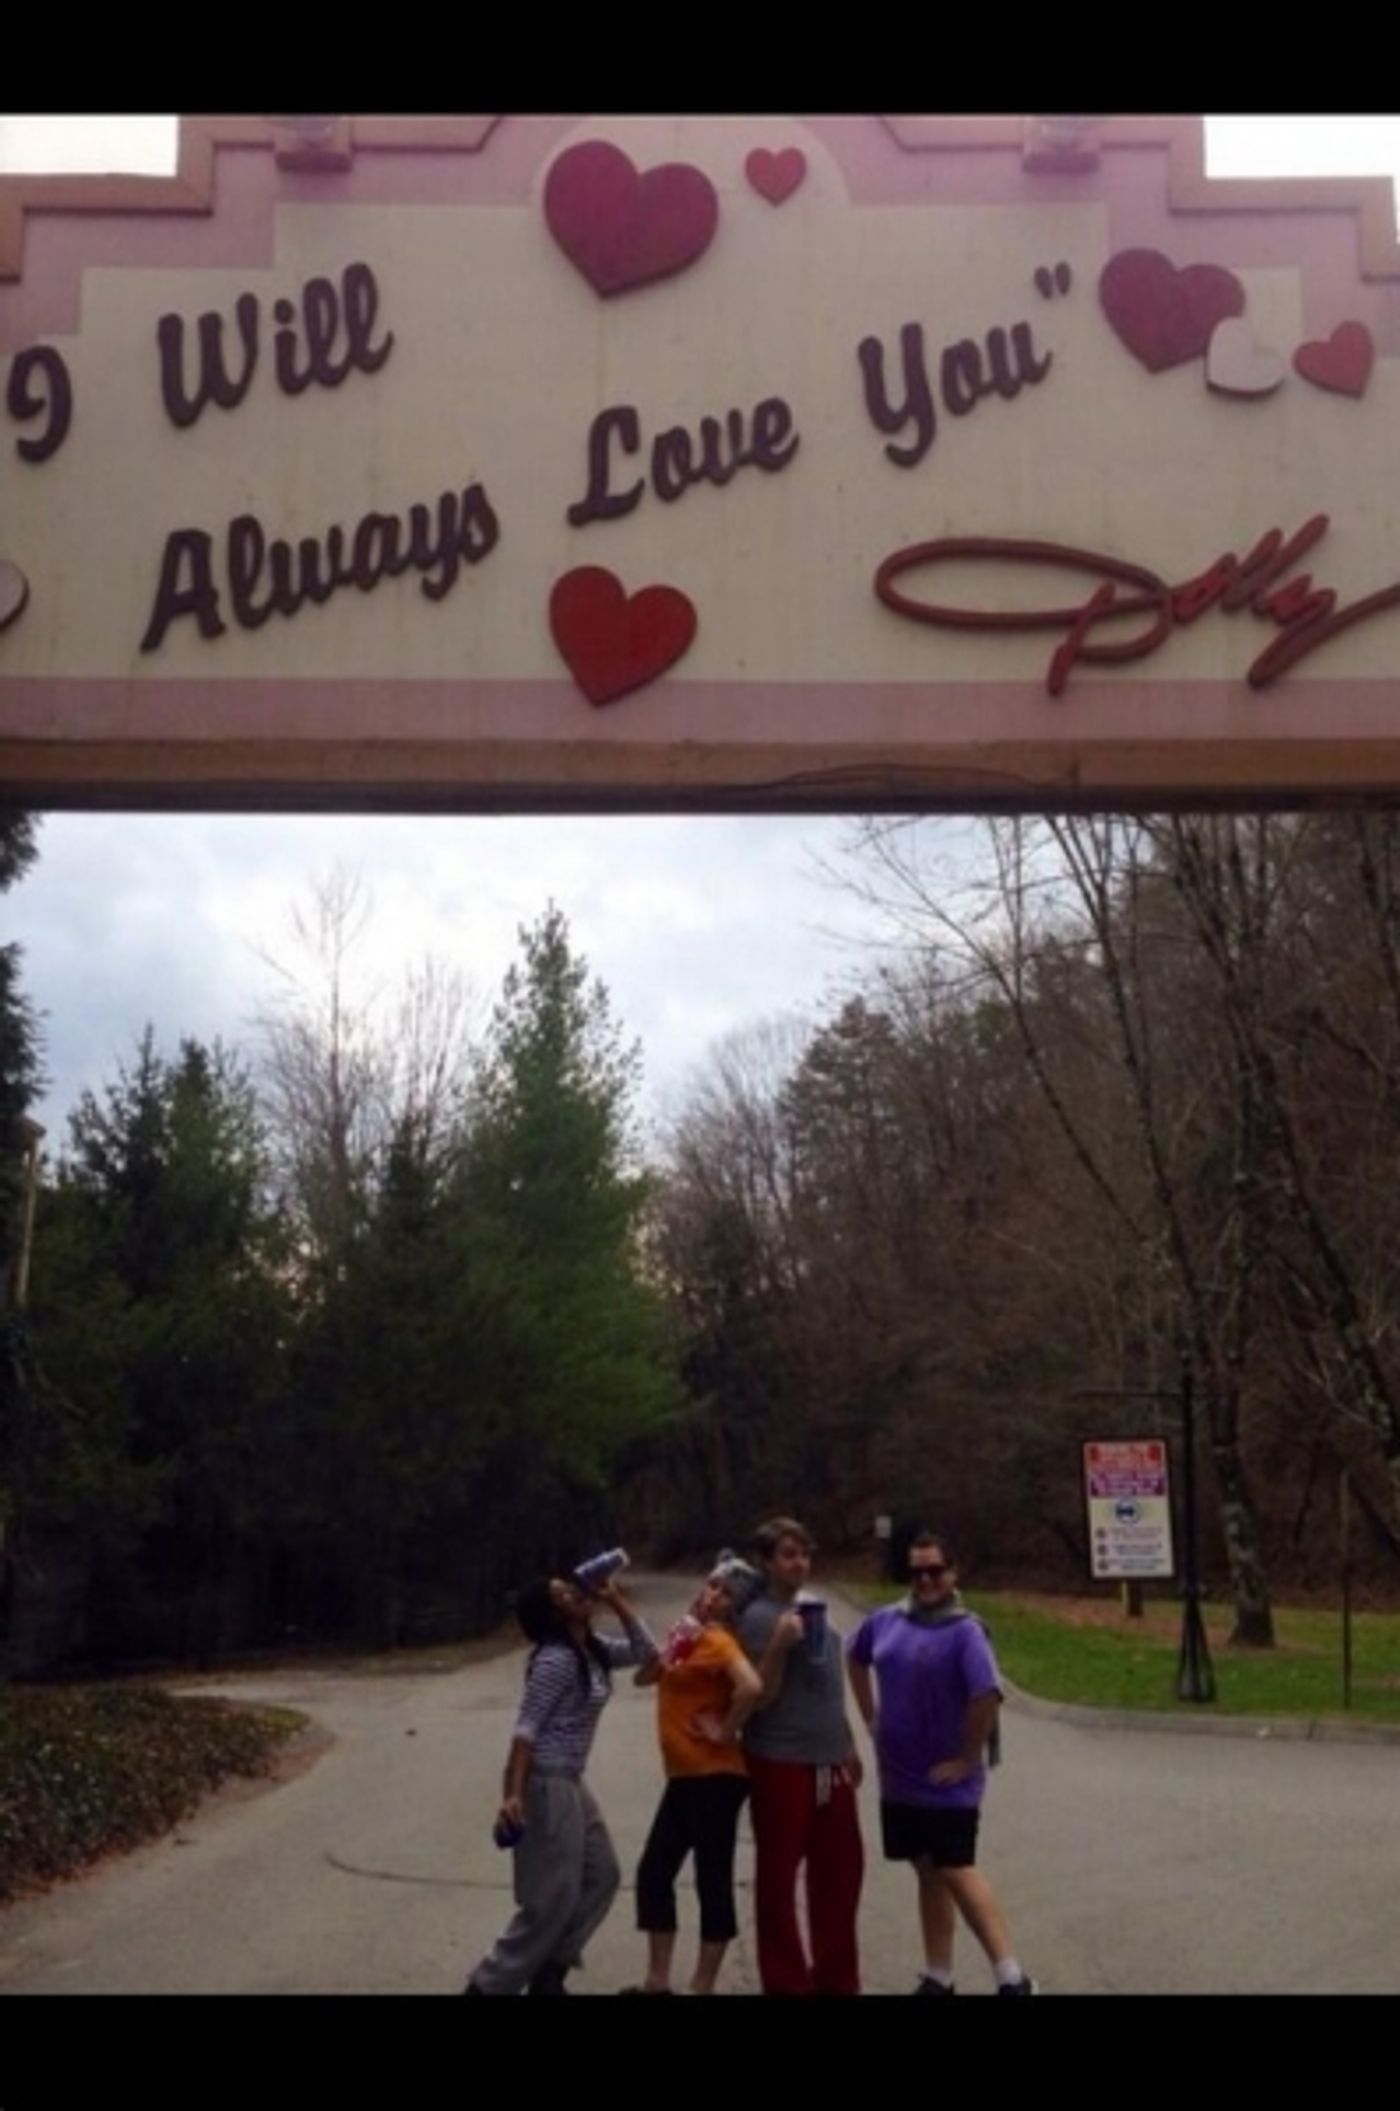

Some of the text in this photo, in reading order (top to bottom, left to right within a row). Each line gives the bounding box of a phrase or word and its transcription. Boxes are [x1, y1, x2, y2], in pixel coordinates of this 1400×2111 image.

[6, 261, 395, 464] I Will
[139, 482, 500, 656] Always
[566, 396, 800, 528] Love
[873, 513, 1400, 696] Dolly
